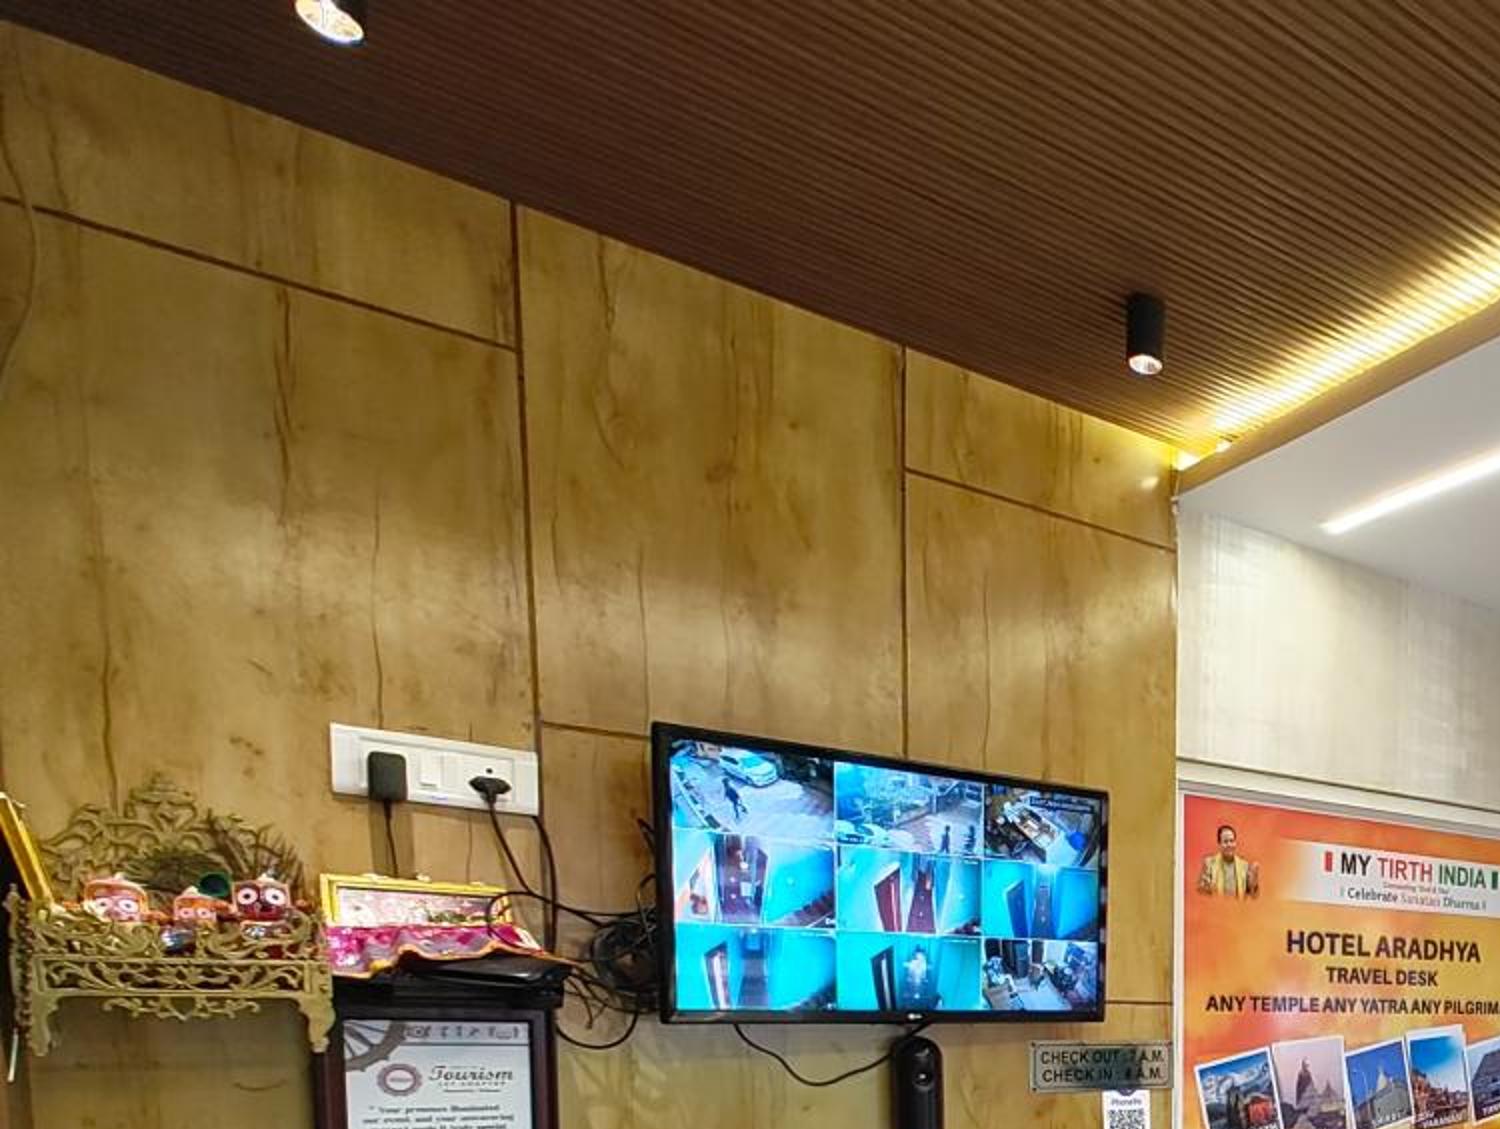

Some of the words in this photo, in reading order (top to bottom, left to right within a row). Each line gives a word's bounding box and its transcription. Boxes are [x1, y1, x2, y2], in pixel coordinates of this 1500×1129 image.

[1341, 853, 1370, 878] MY
[1378, 858, 1432, 883] TIRTH
[1439, 863, 1487, 889] INDIA
[1347, 887, 1398, 902] Celebrate
[1443, 896, 1479, 911] Dharma
[1286, 930, 1370, 958] HOTEL
[1375, 936, 1481, 963] ARADHYA
[1325, 966, 1393, 985] TRAVEL
[1396, 969, 1438, 987] DESK
[1206, 995, 1245, 1012] ANY
[1249, 995, 1320, 1013] TEMPLE
[1322, 998, 1358, 1014] ANY
[1361, 999, 1408, 1015] YATRA
[1411, 1000, 1441, 1015] ANY
[1040, 1050, 1088, 1065] CHECK
[1093, 1050, 1118, 1064] OUT
[429, 1064, 513, 1081] Tourism
[1042, 1069, 1094, 1083] CHECK
[1101, 1069, 1113, 1082] IN
